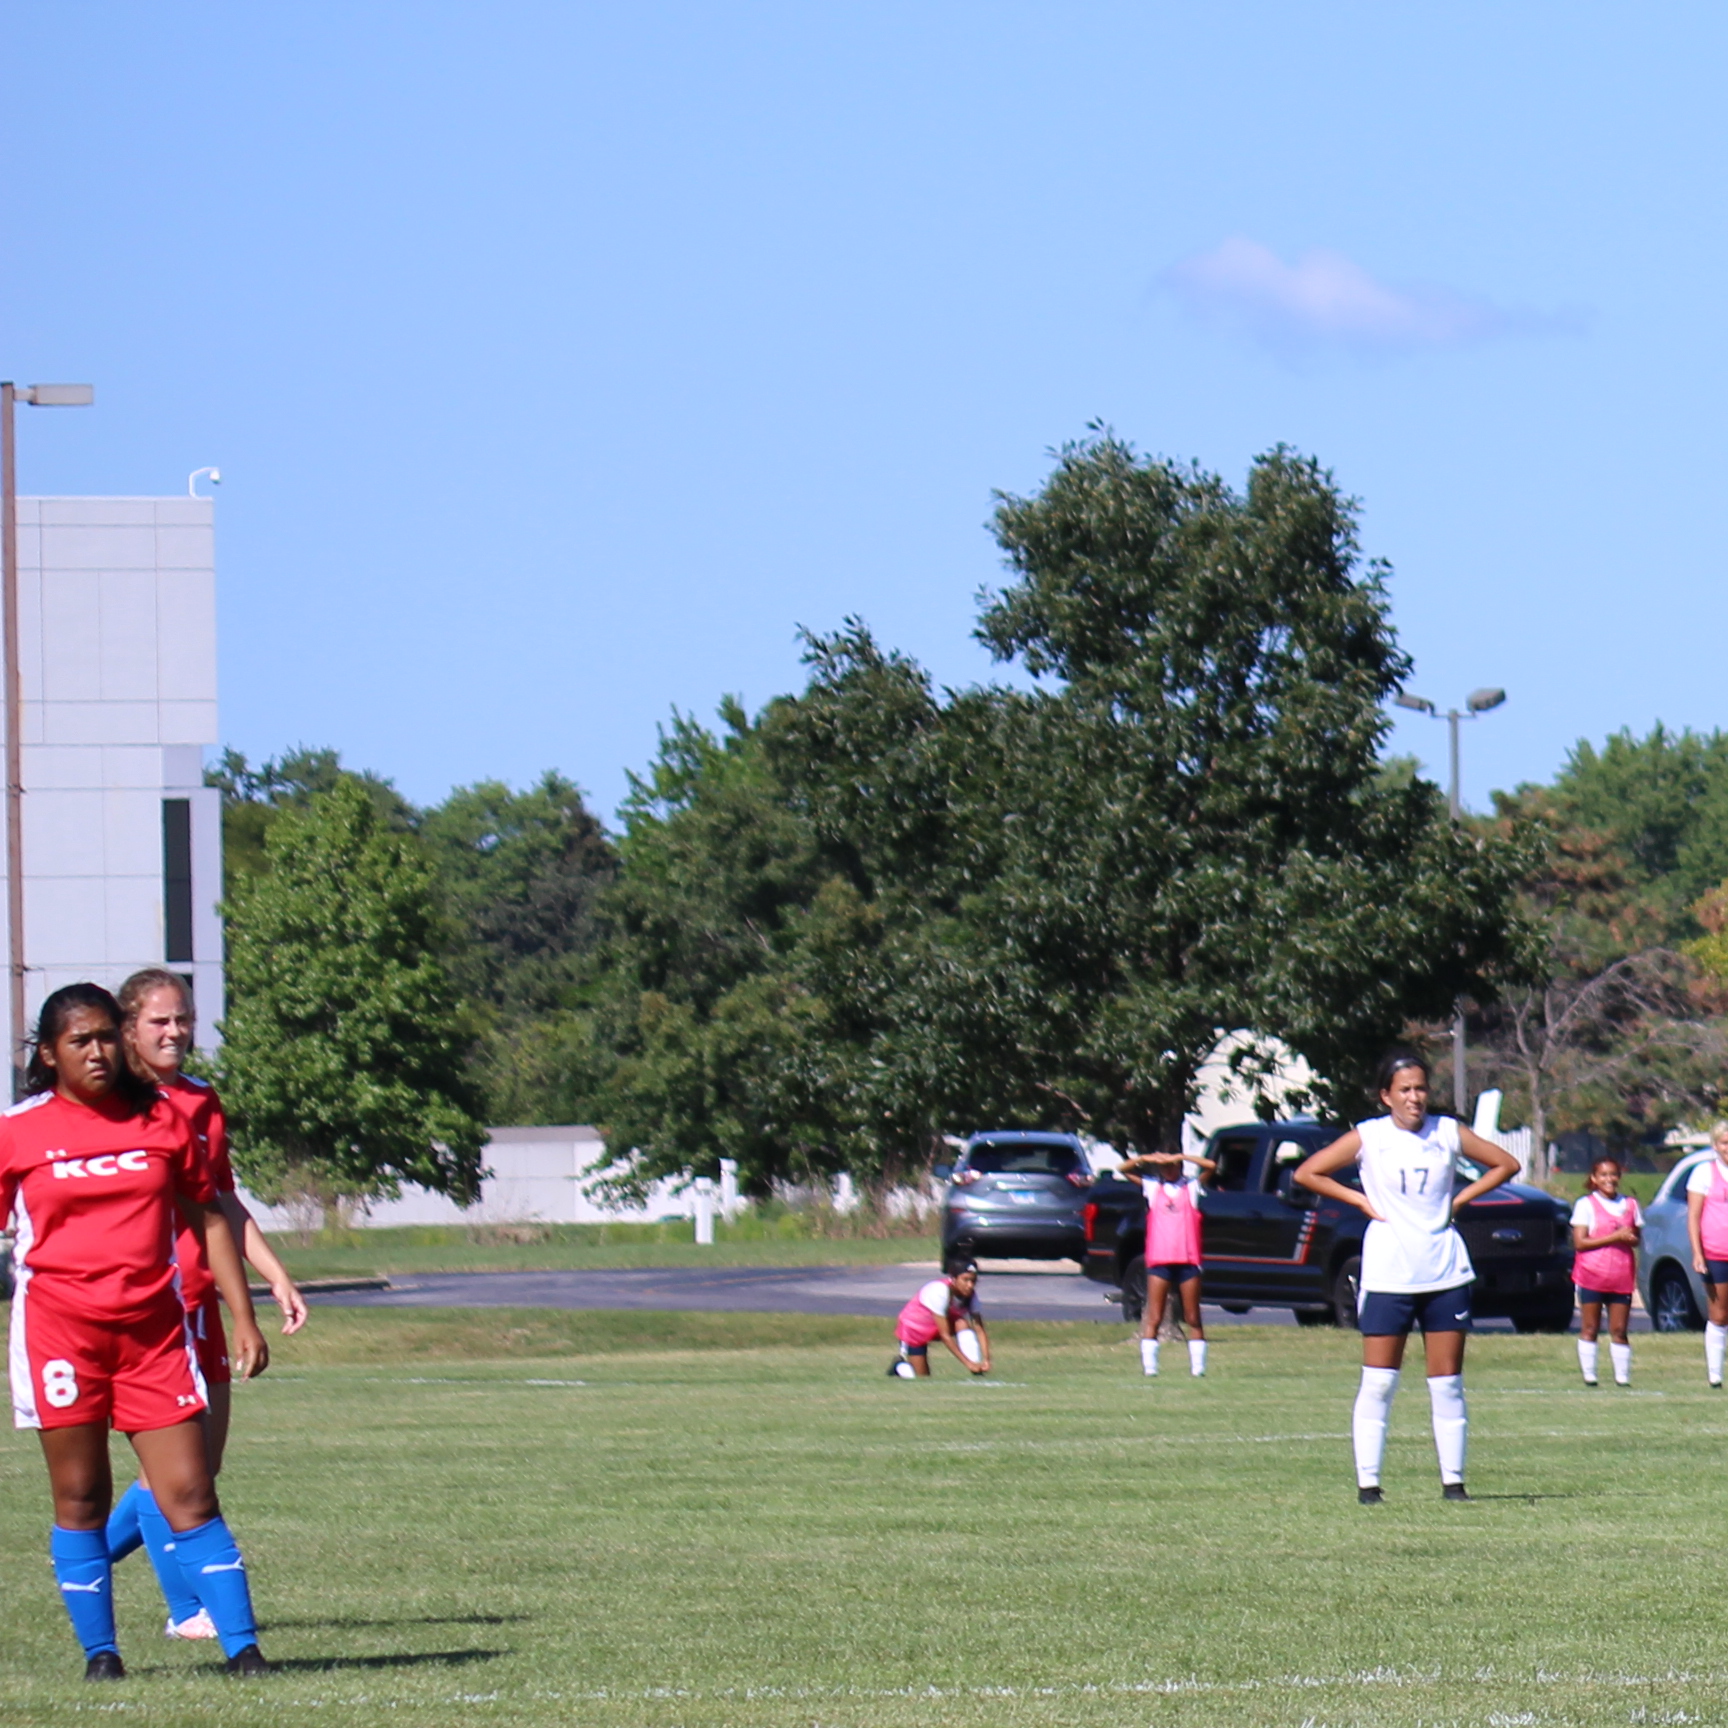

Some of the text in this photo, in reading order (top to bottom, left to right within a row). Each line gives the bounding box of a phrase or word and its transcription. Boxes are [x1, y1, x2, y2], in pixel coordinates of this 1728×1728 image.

[52, 1149, 149, 1179] KCC
[1399, 1167, 1428, 1194] 17
[42, 1358, 79, 1409] 8
